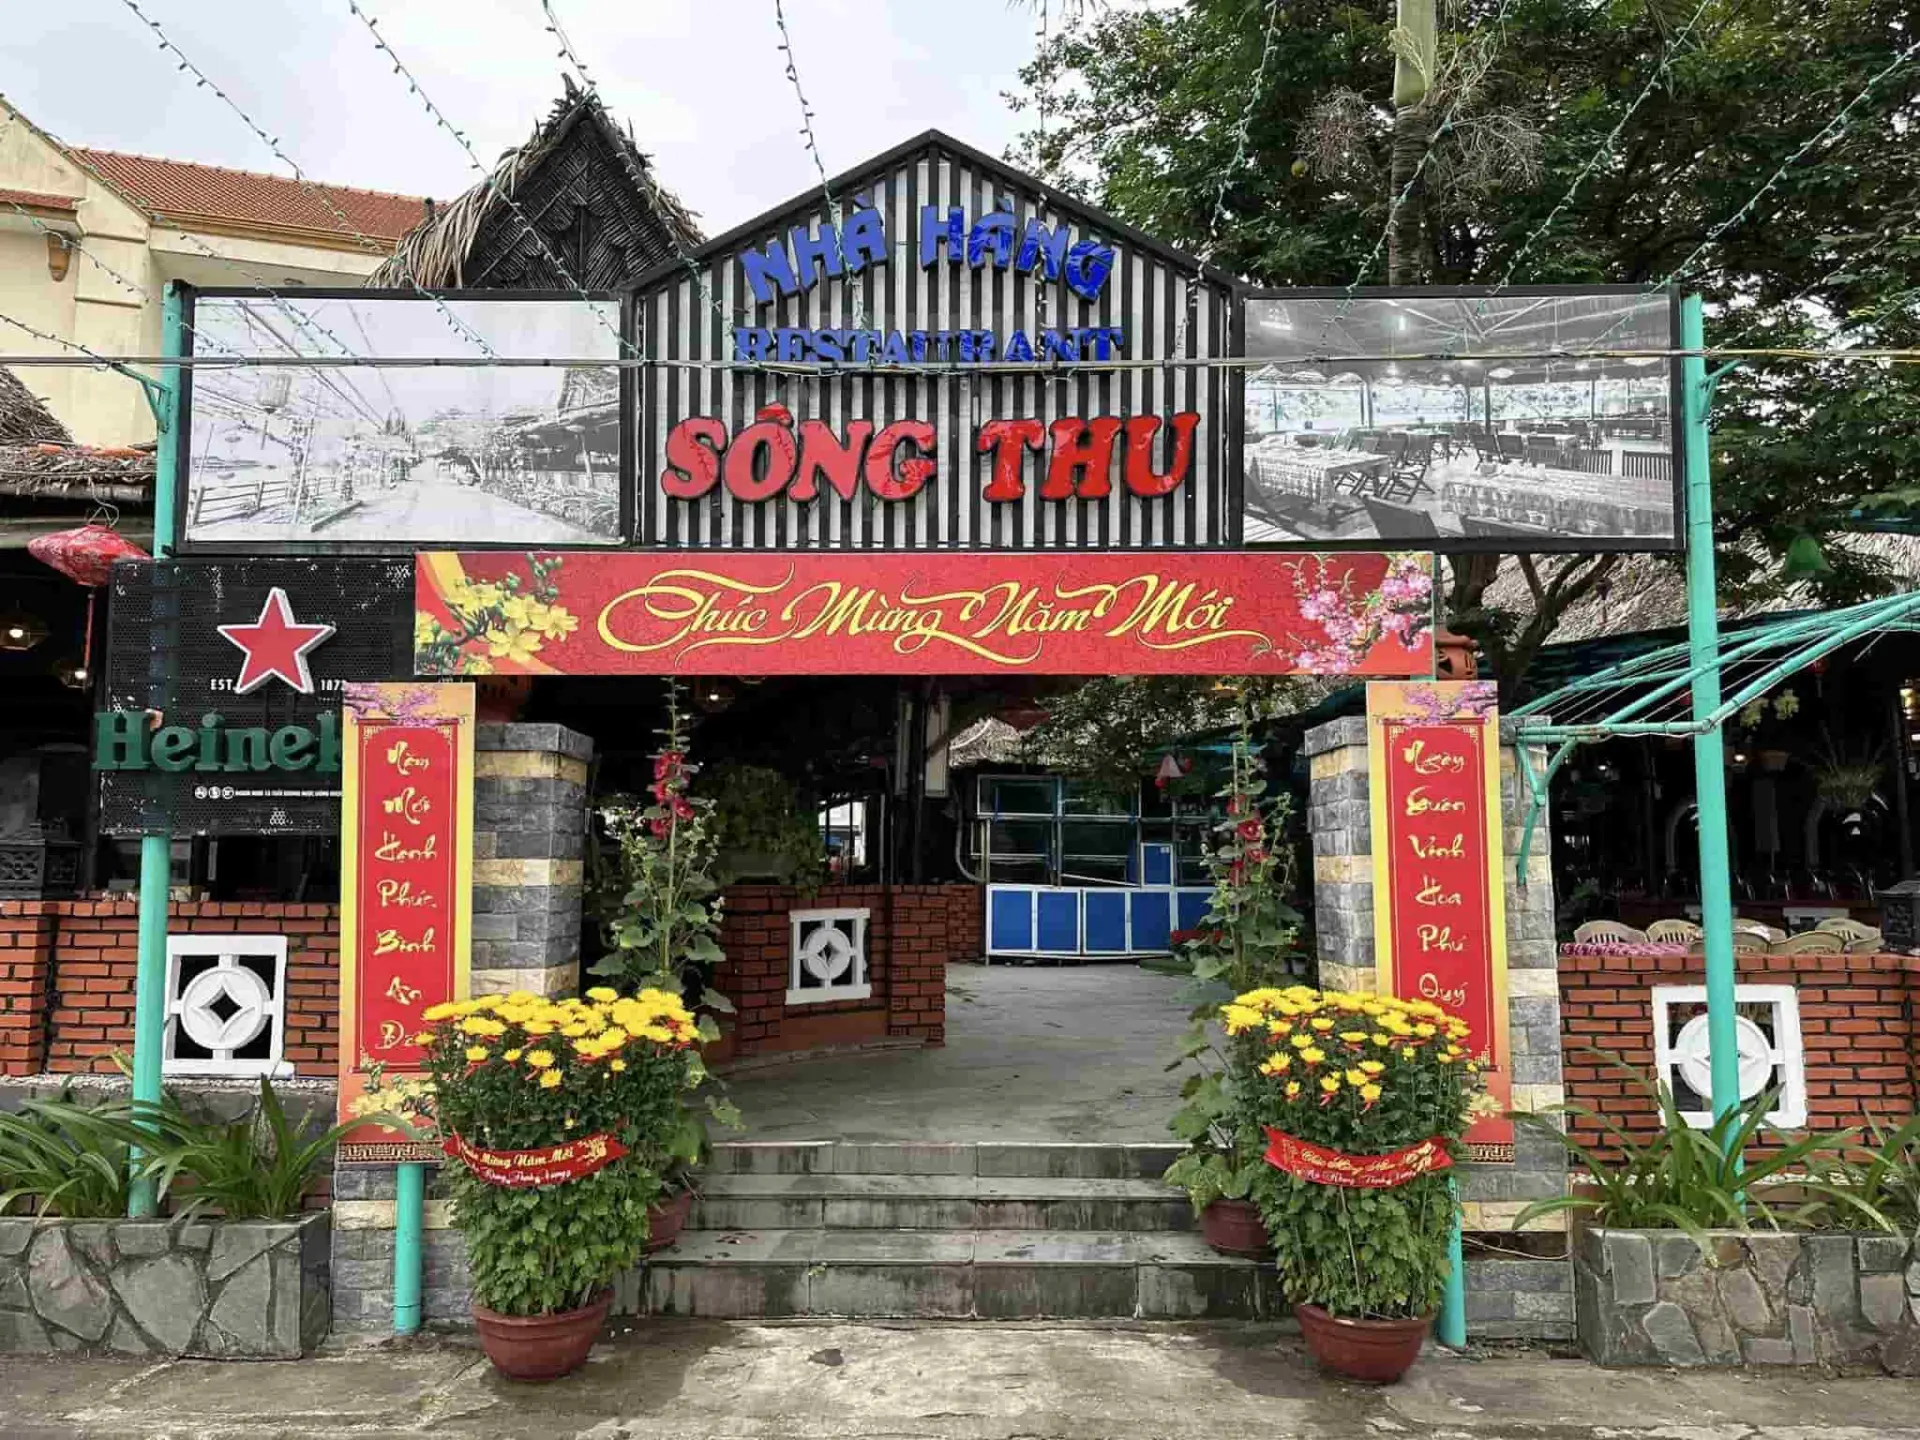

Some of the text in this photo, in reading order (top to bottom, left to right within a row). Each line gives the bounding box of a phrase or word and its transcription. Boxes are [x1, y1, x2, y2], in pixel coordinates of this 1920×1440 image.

[740, 194, 1115, 306] NHÀ HÀNG
[734, 327, 1124, 368] RESTAURANT
[660, 402, 1201, 502] SÔNG THU
[598, 562, 1242, 655] Chúc Mừng Năm Mới
[91, 711, 341, 773] Heinek
